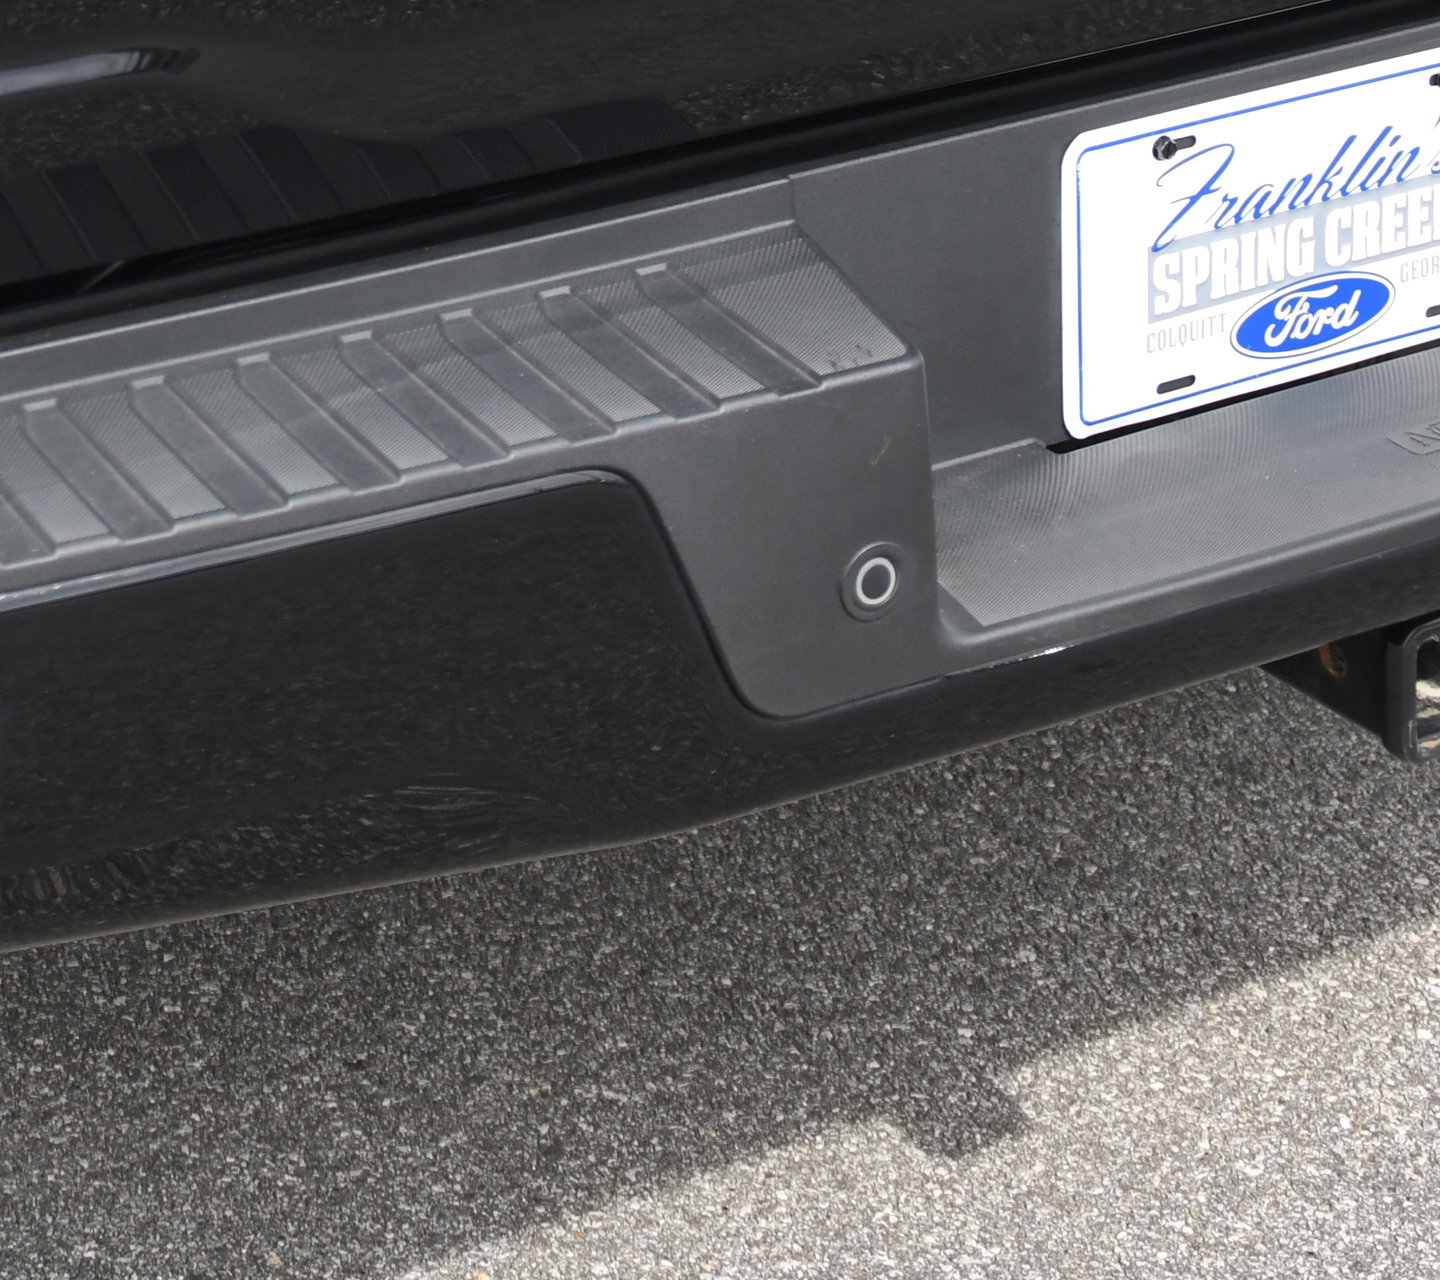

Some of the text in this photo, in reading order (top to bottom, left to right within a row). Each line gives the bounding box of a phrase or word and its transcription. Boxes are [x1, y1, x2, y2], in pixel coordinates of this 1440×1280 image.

[1152, 216, 1316, 316] SPRING
[1146, 312, 1228, 354] COLQUITT
[1263, 284, 1363, 348] Ford
